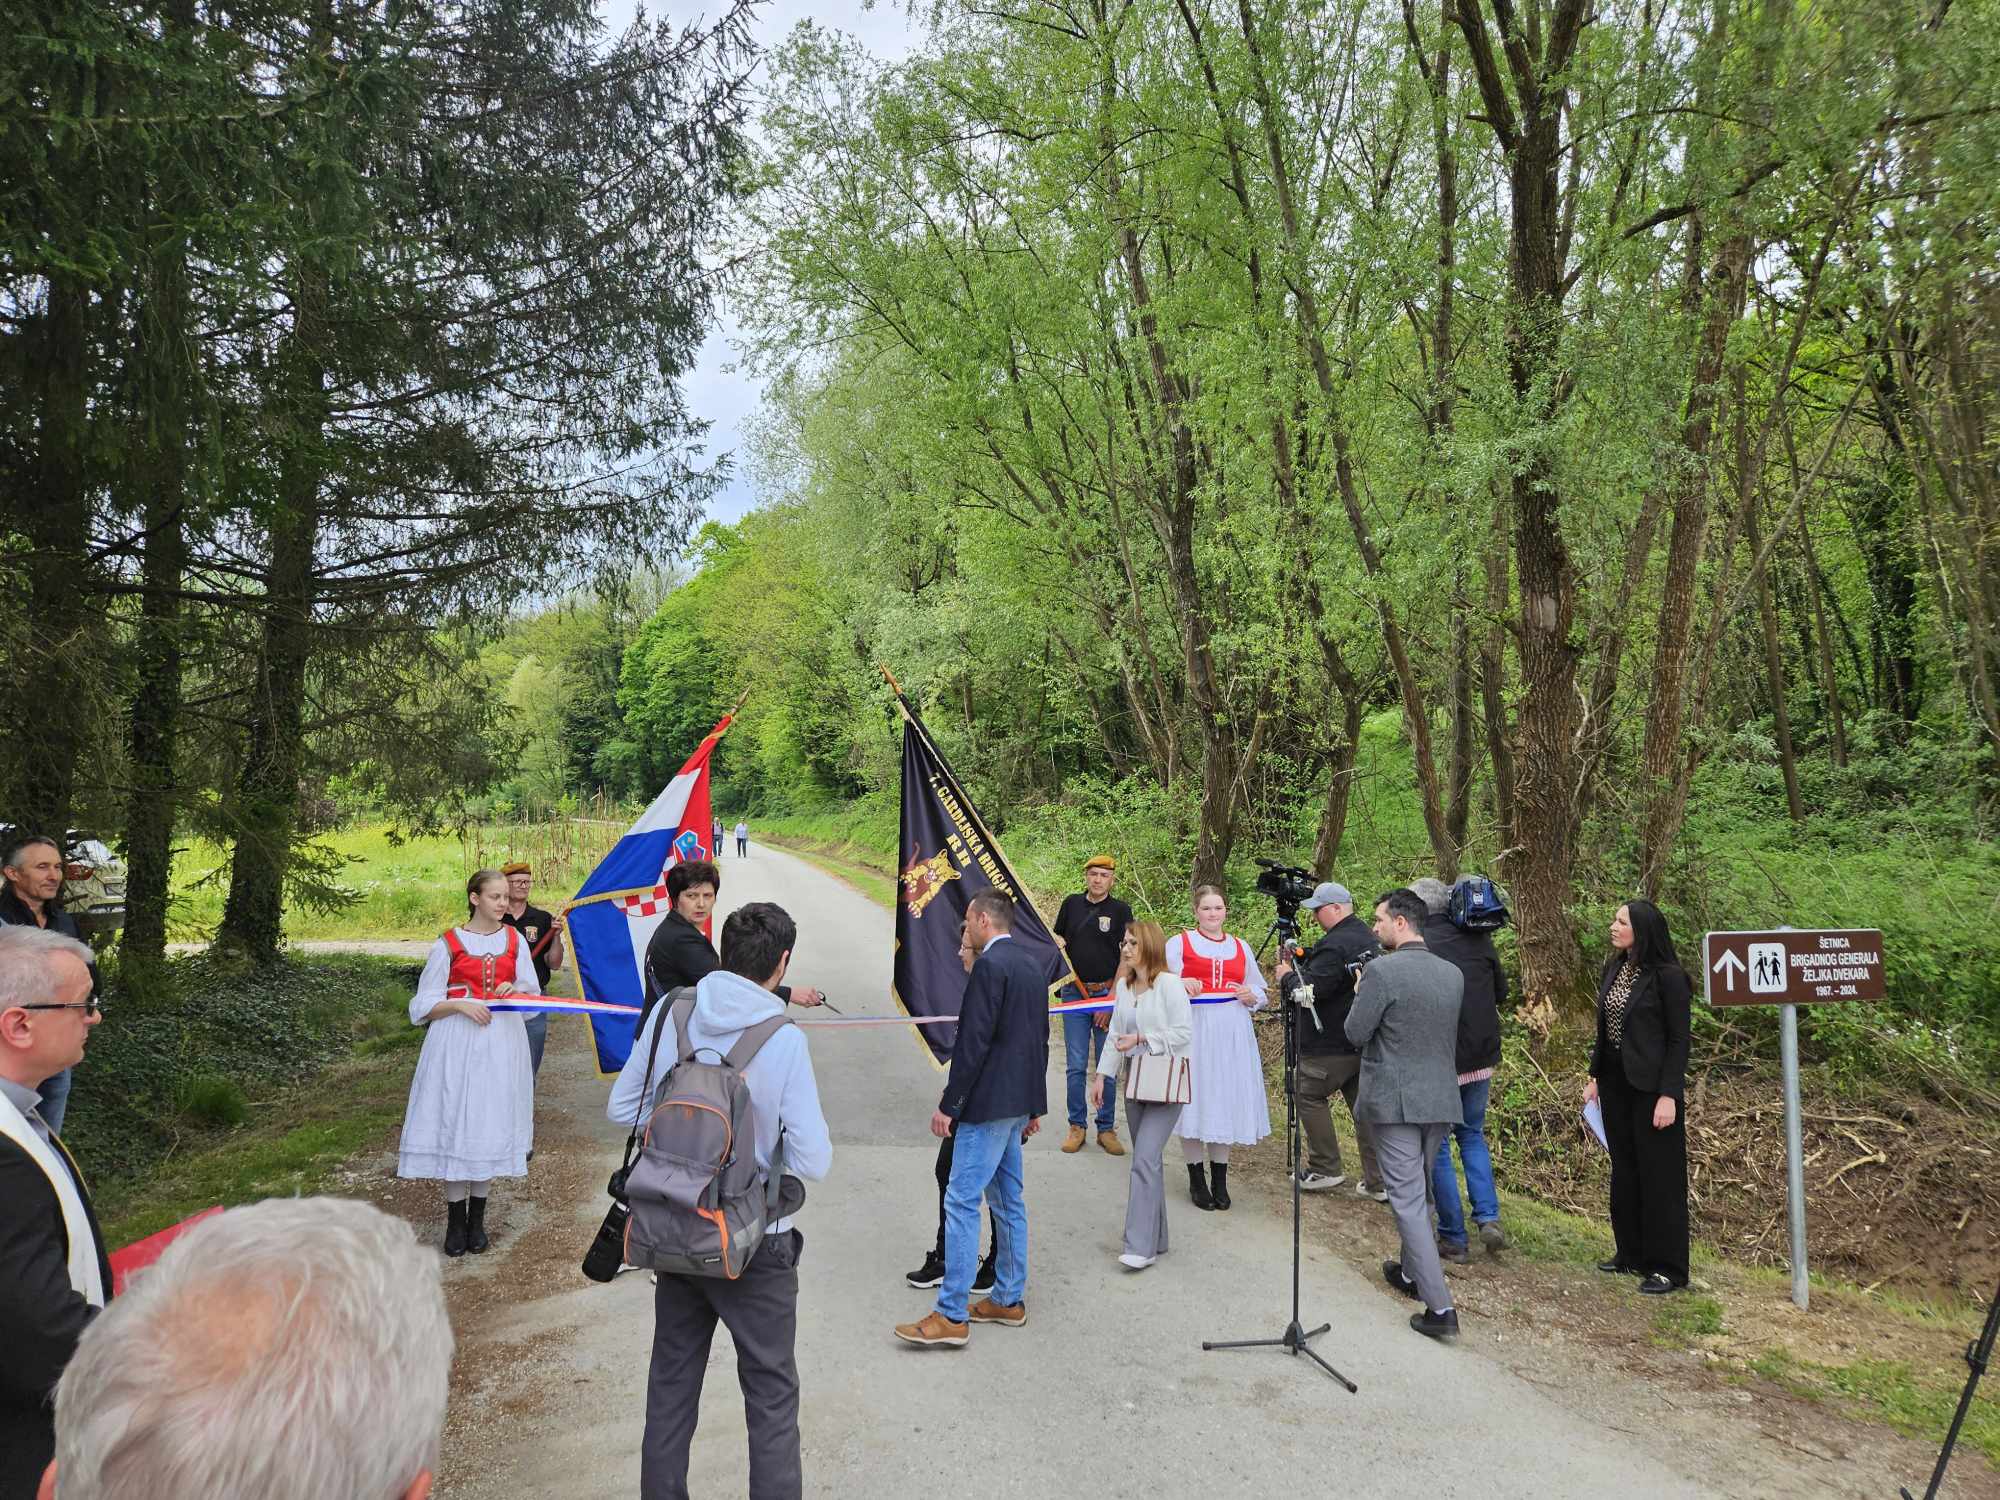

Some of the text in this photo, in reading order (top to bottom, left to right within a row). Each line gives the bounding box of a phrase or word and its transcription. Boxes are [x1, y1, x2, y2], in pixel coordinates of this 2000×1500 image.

[929, 772, 941, 788] 7.
[937, 786, 984, 856] GARDIJSKA
[1819, 936, 1850, 949] ŠETNICA
[1790, 952, 1879, 967] BRIGADNOG GENERALA
[1802, 967, 1870, 982] ŽELJKA DVEKARA
[1840, 985, 1858, 995] 2024.
